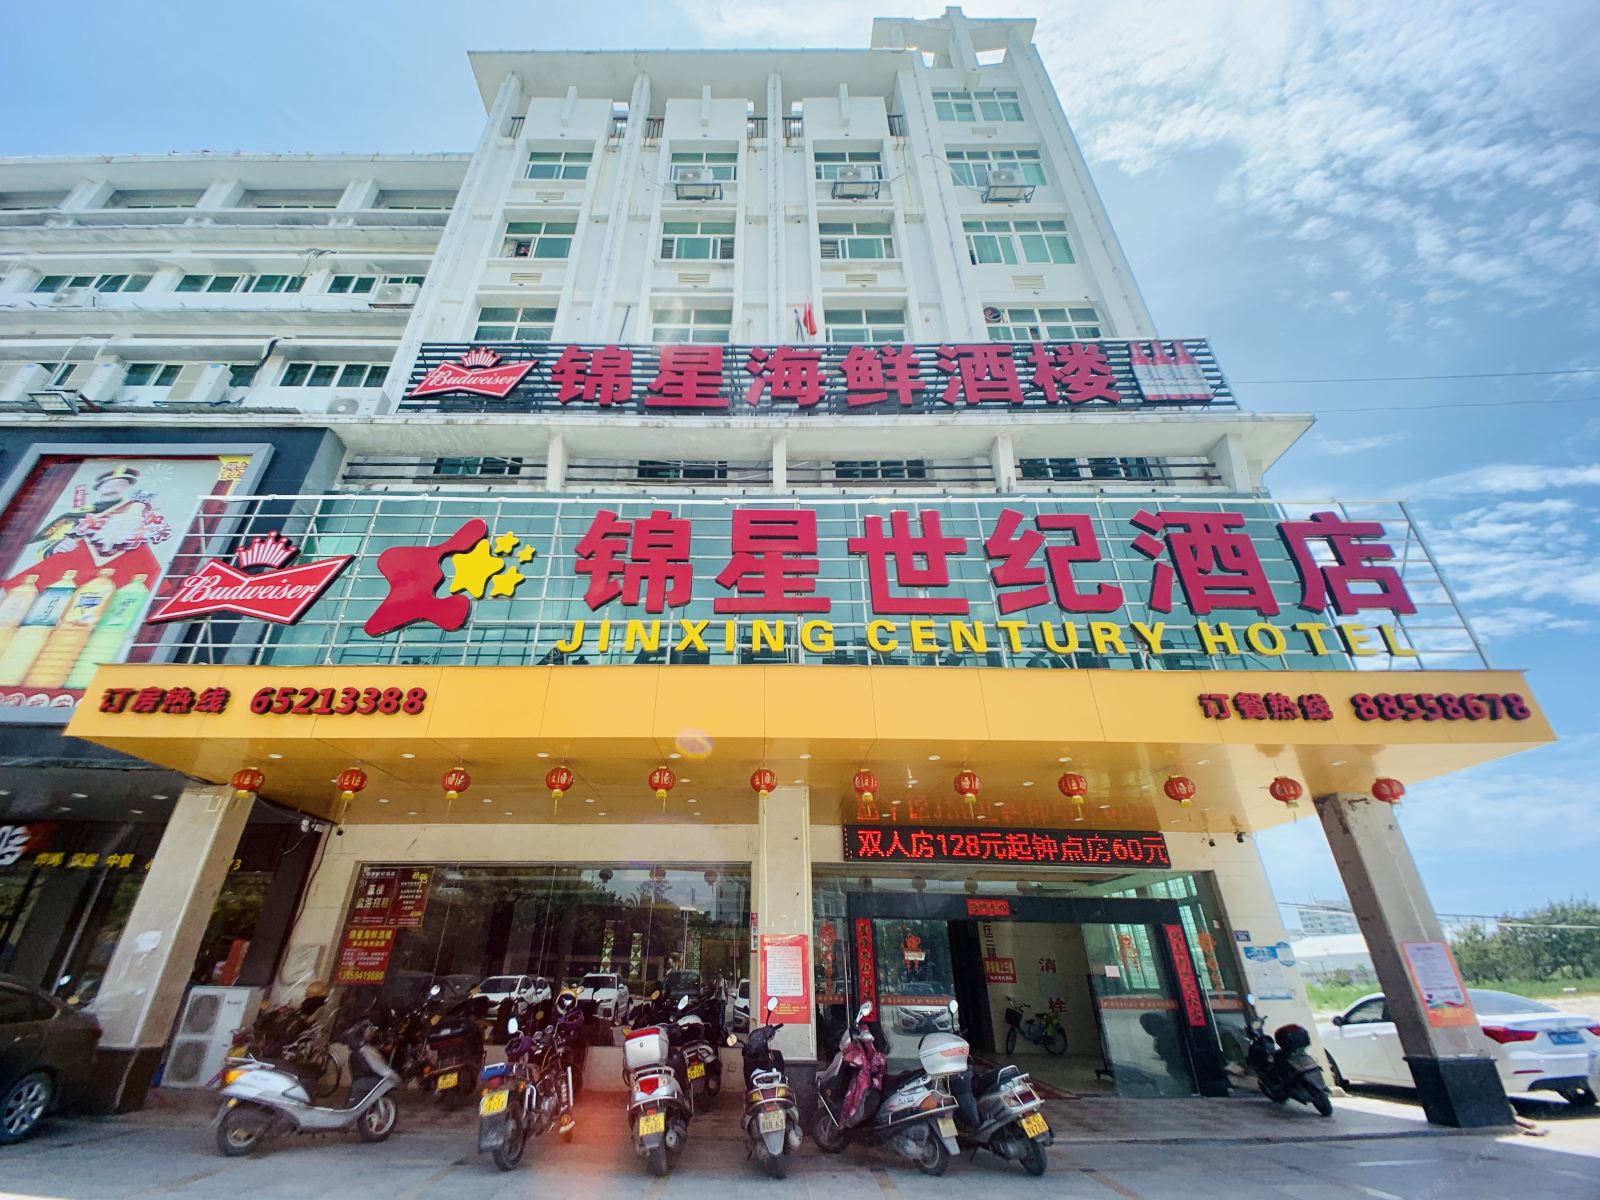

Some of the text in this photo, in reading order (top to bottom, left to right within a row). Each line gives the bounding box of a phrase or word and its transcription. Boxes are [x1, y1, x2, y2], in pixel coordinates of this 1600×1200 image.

[426, 368, 517, 387] Budweiser
[551, 343, 1122, 409] 锦星海鲜酒楼
[574, 508, 1418, 616] 锦星世纪酒店
[182, 573, 317, 604] Budweiser
[556, 619, 1419, 658] JINXING CENTURY HOTEL
[99, 687, 231, 714] 订房热线
[250, 687, 427, 715] 65213388
[1198, 692, 1532, 721] 订餐热线 88558678
